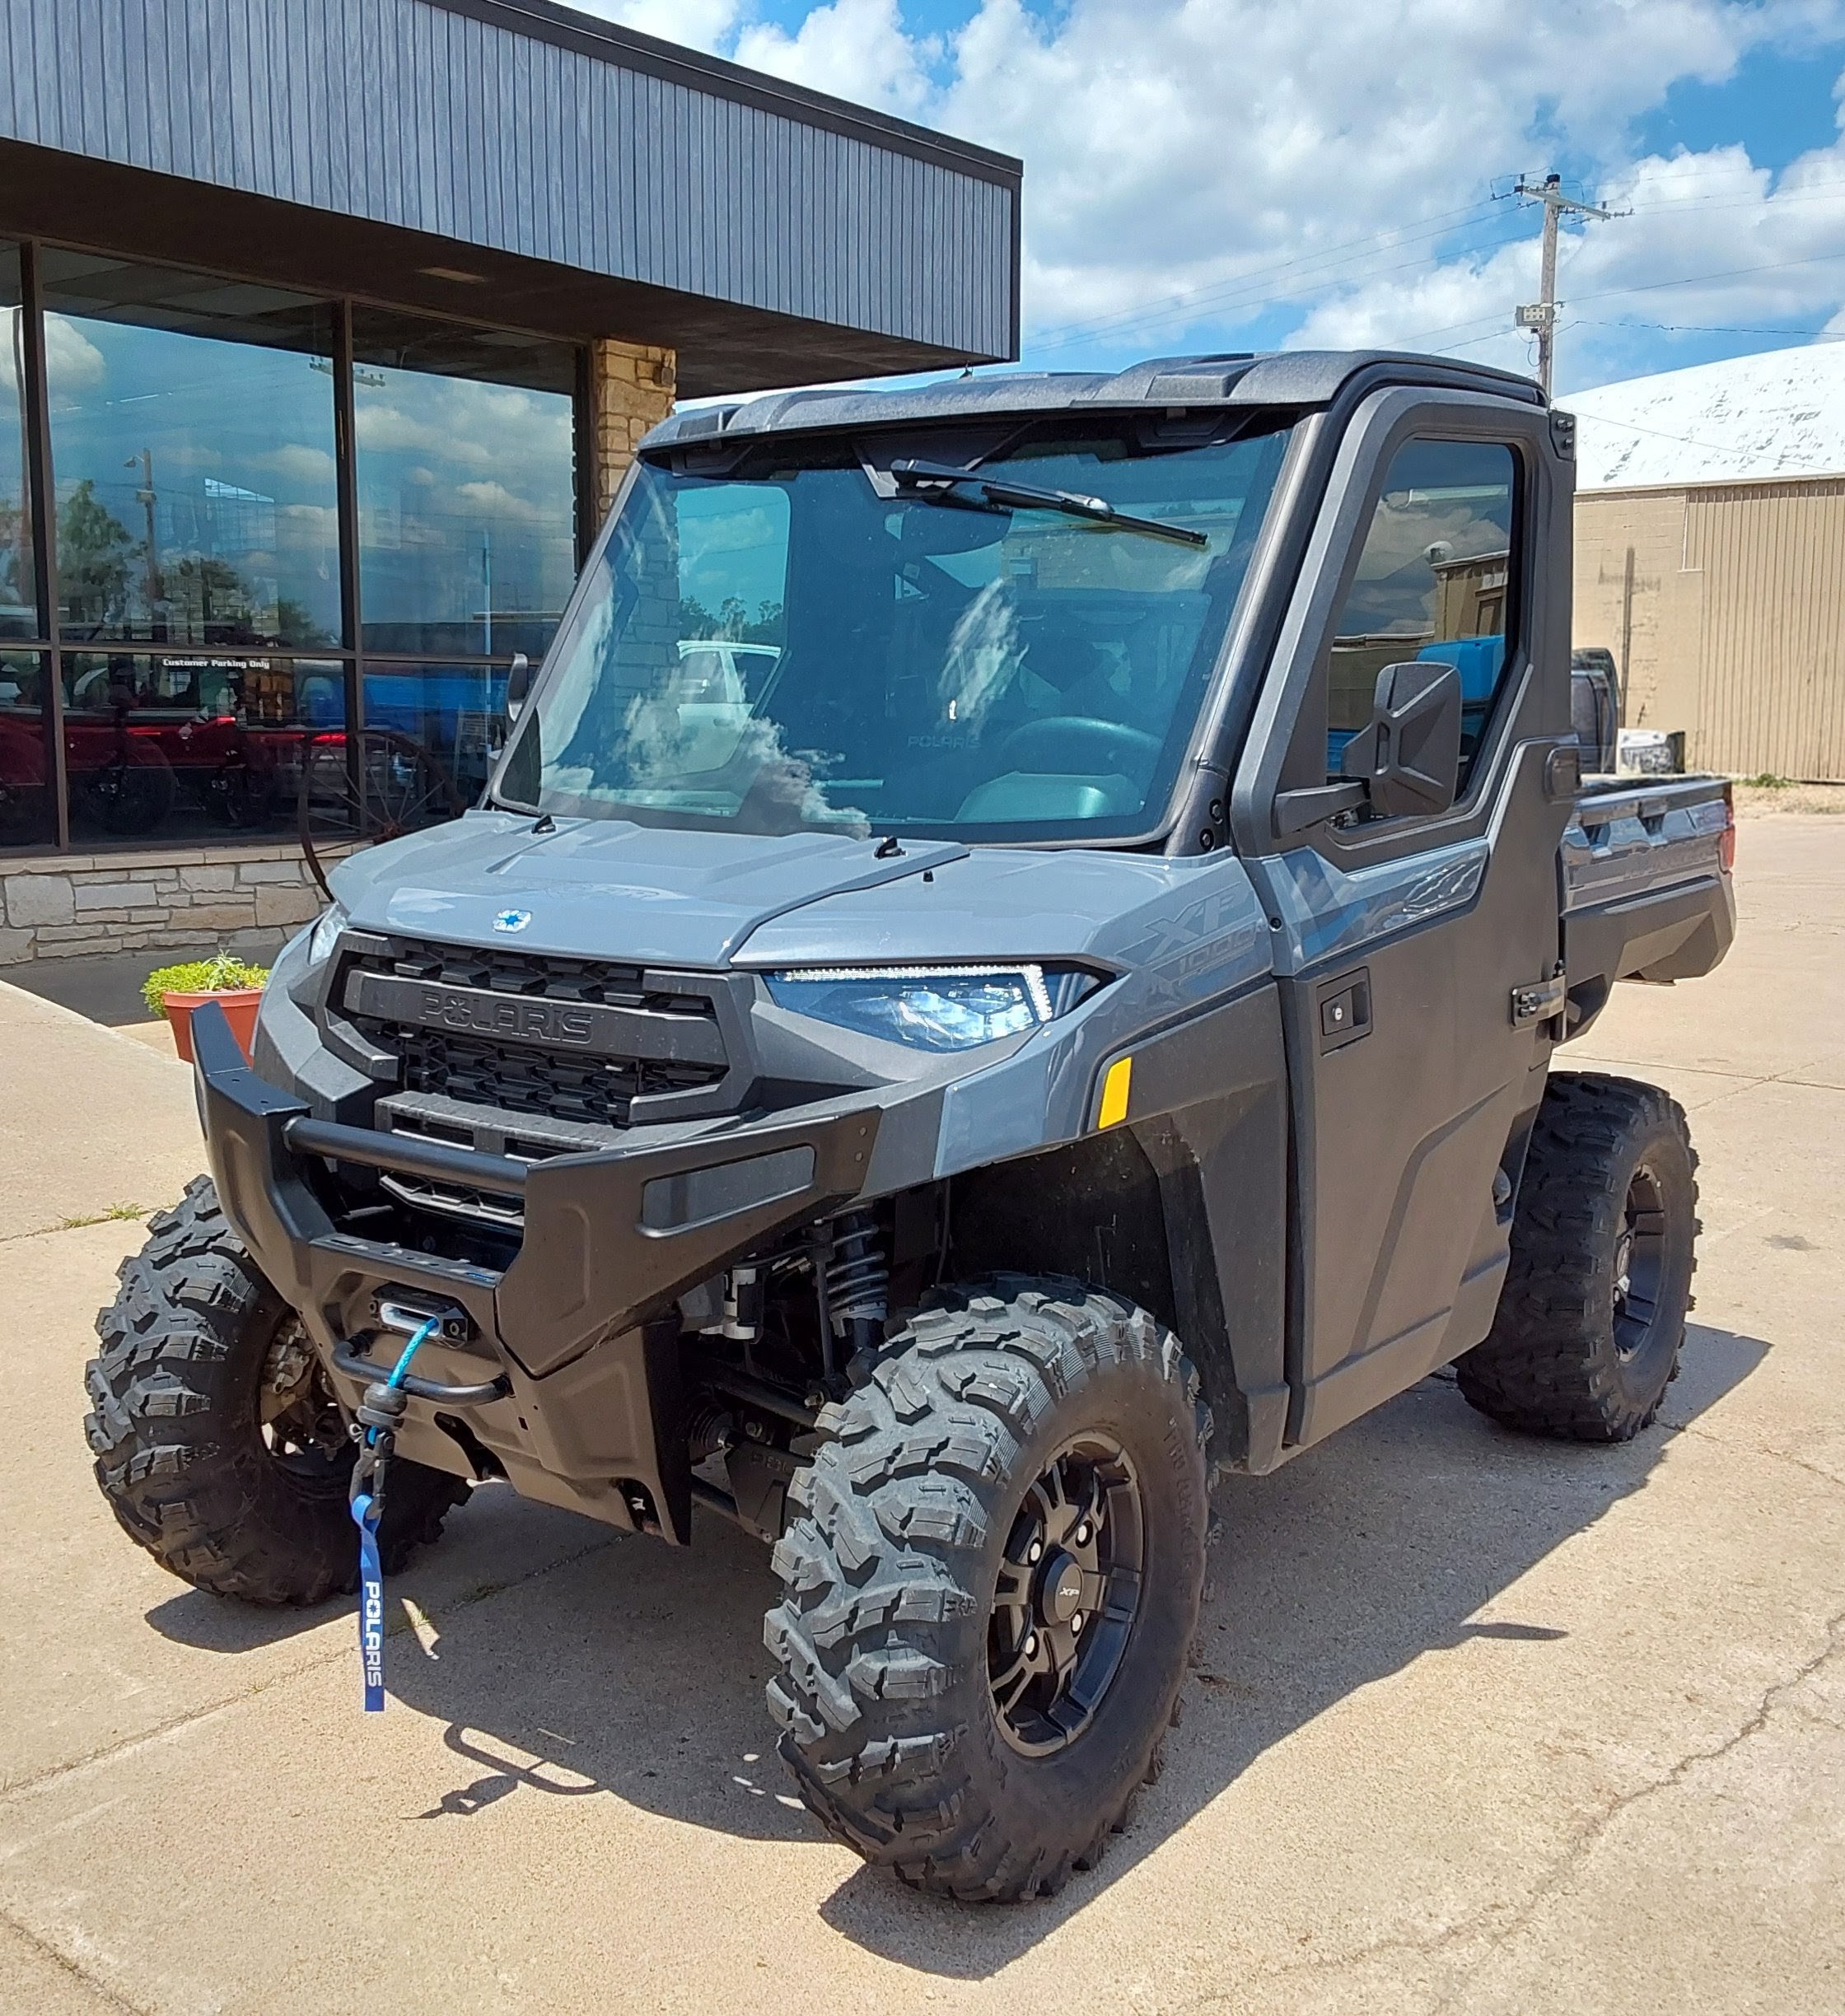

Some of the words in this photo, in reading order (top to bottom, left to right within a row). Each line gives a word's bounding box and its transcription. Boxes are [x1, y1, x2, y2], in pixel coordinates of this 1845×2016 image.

[212, 660, 246, 669] Parking
[249, 660, 269, 669] Only
[1143, 883, 1254, 965] XP
[1179, 921, 1256, 975] 1000
[419, 991, 592, 1044] POLARIS
[1059, 1587, 1080, 1596] XP
[366, 1581, 381, 1687] POLARIS
